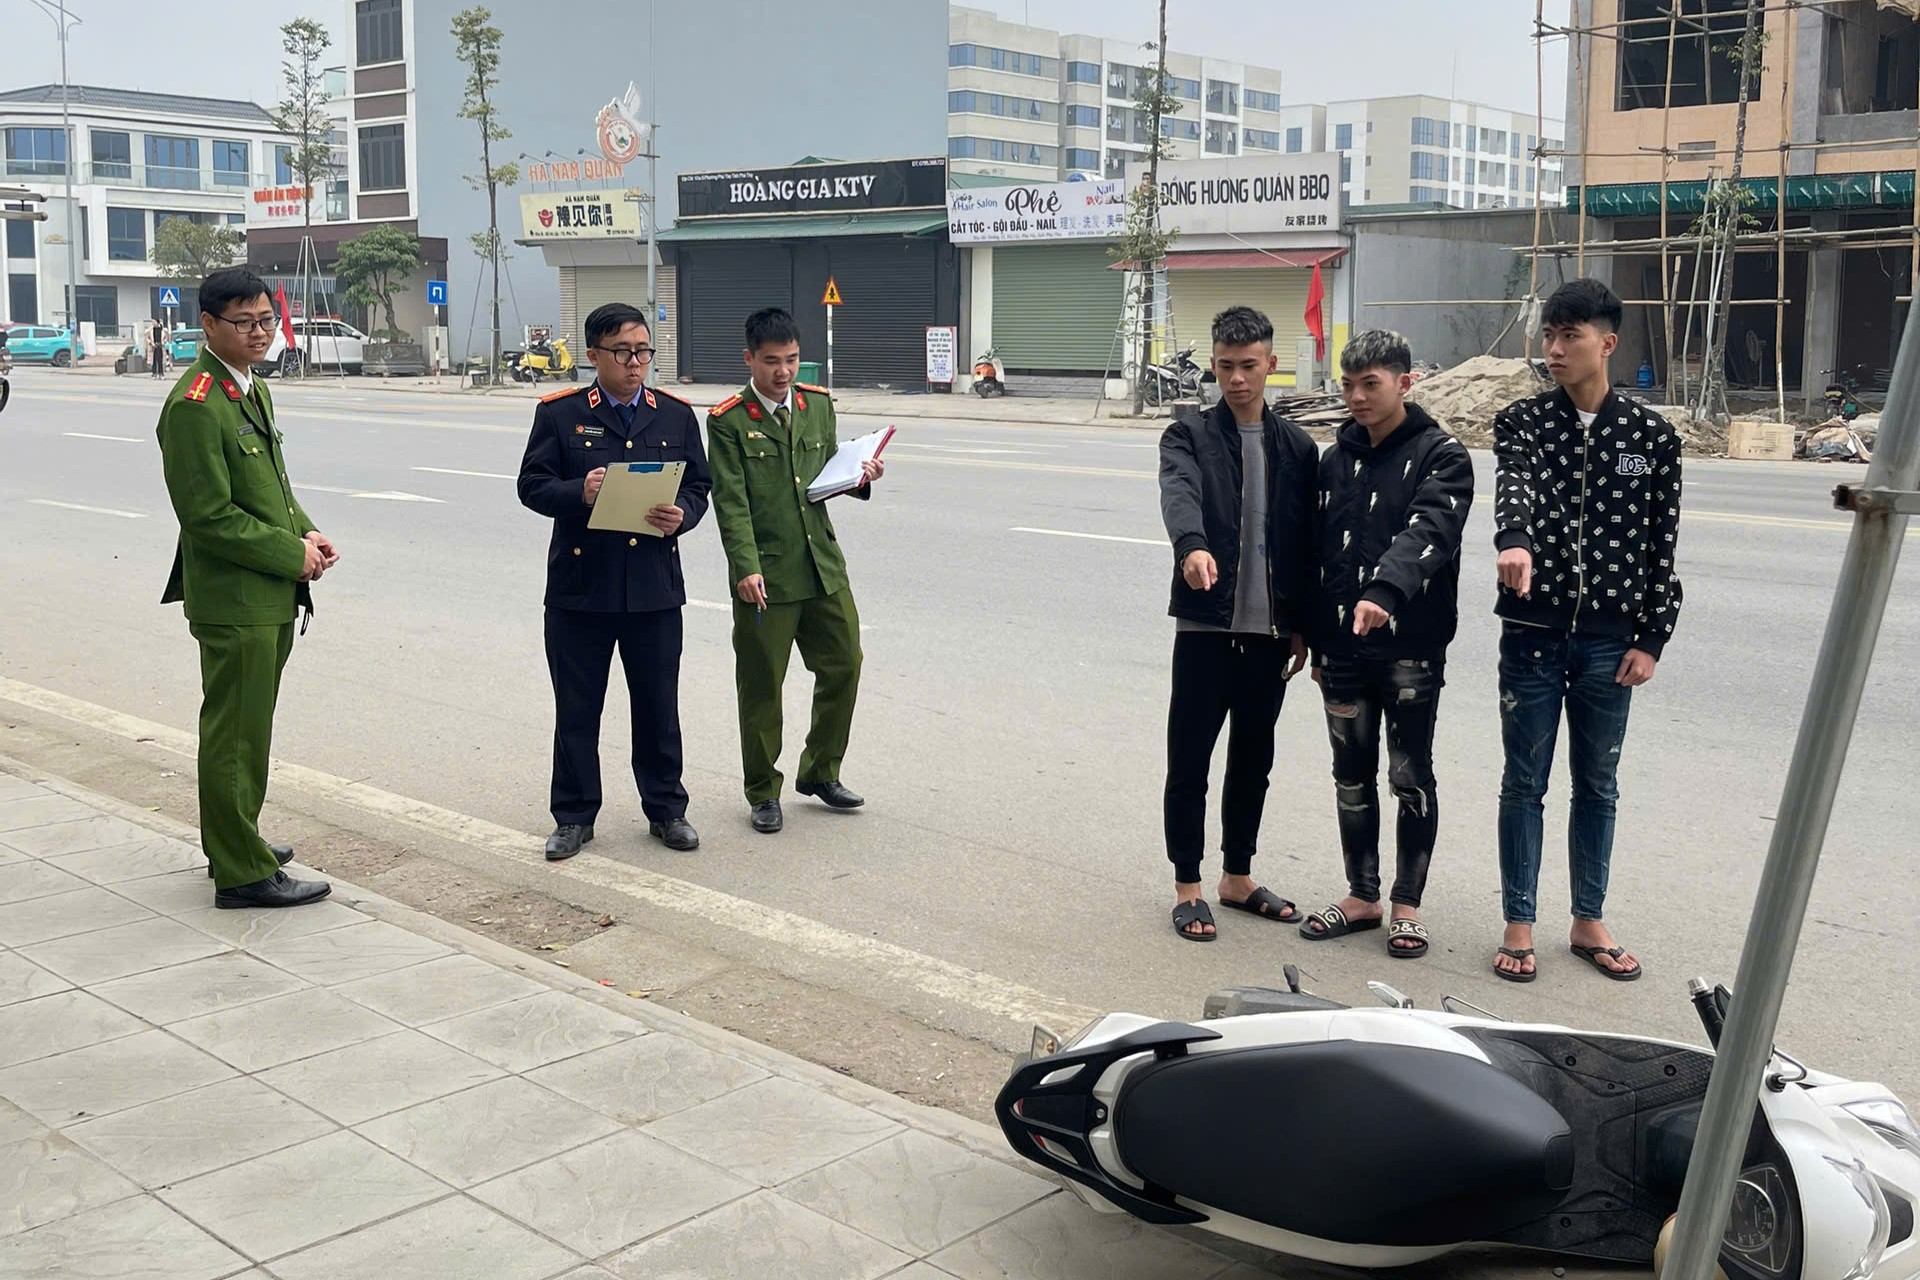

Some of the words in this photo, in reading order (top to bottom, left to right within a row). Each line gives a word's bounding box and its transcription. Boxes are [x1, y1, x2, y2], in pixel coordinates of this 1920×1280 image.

[551, 161, 581, 180] NAM
[729, 176, 794, 203] HOÀNG
[796, 178, 833, 200] GIA
[834, 175, 877, 198] KTV
[1096, 183, 1115, 196] Nail
[1253, 172, 1295, 203] QUÁN
[1299, 174, 1330, 201] BBQ
[957, 202, 974, 211] Hair
[976, 198, 998, 208] Salon
[1005, 188, 1062, 216] Phệ
[951, 218, 967, 234] CẮT
[969, 219, 985, 233] TÓC
[993, 218, 1008, 234] GỘI
[1036, 218, 1057, 231] NAIL
[1619, 453, 1648, 476] DG
[1390, 922, 1428, 937] D&G
